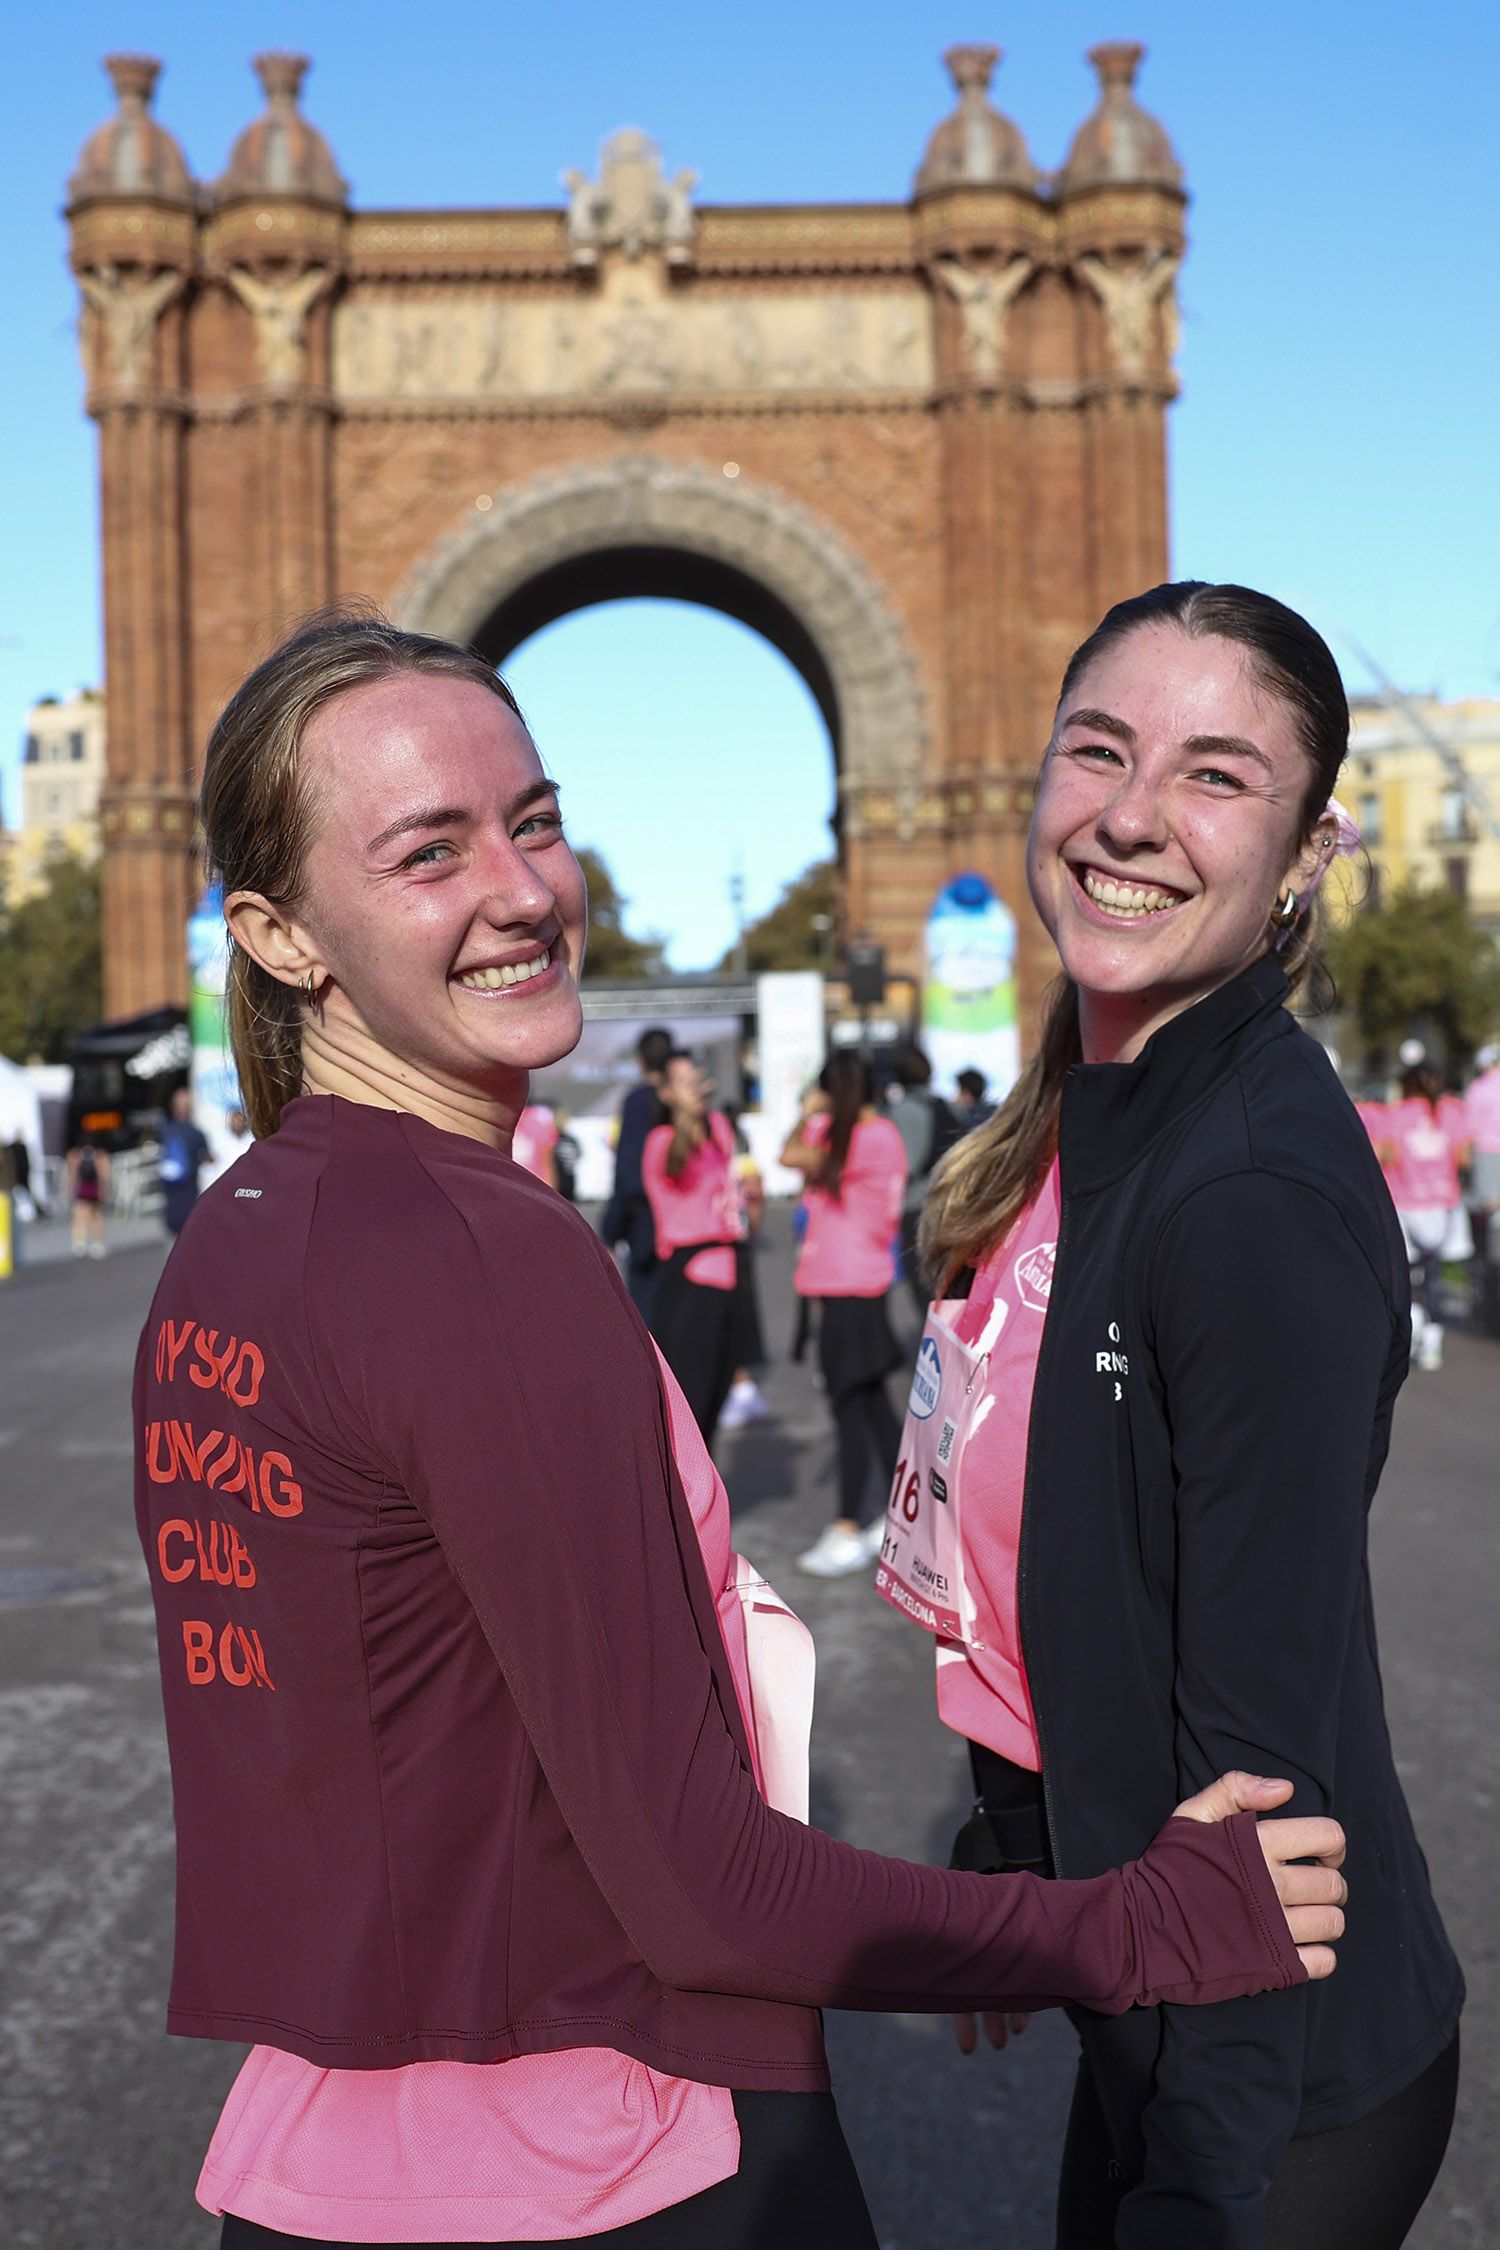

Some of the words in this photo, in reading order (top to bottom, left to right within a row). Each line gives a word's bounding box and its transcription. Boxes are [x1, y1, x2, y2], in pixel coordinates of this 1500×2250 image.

[892, 1459, 920, 1523] 16
[157, 1519, 256, 1589] CLUB
[912, 1556, 948, 1591] HUAWEI
[182, 1620, 276, 1691] BCN
